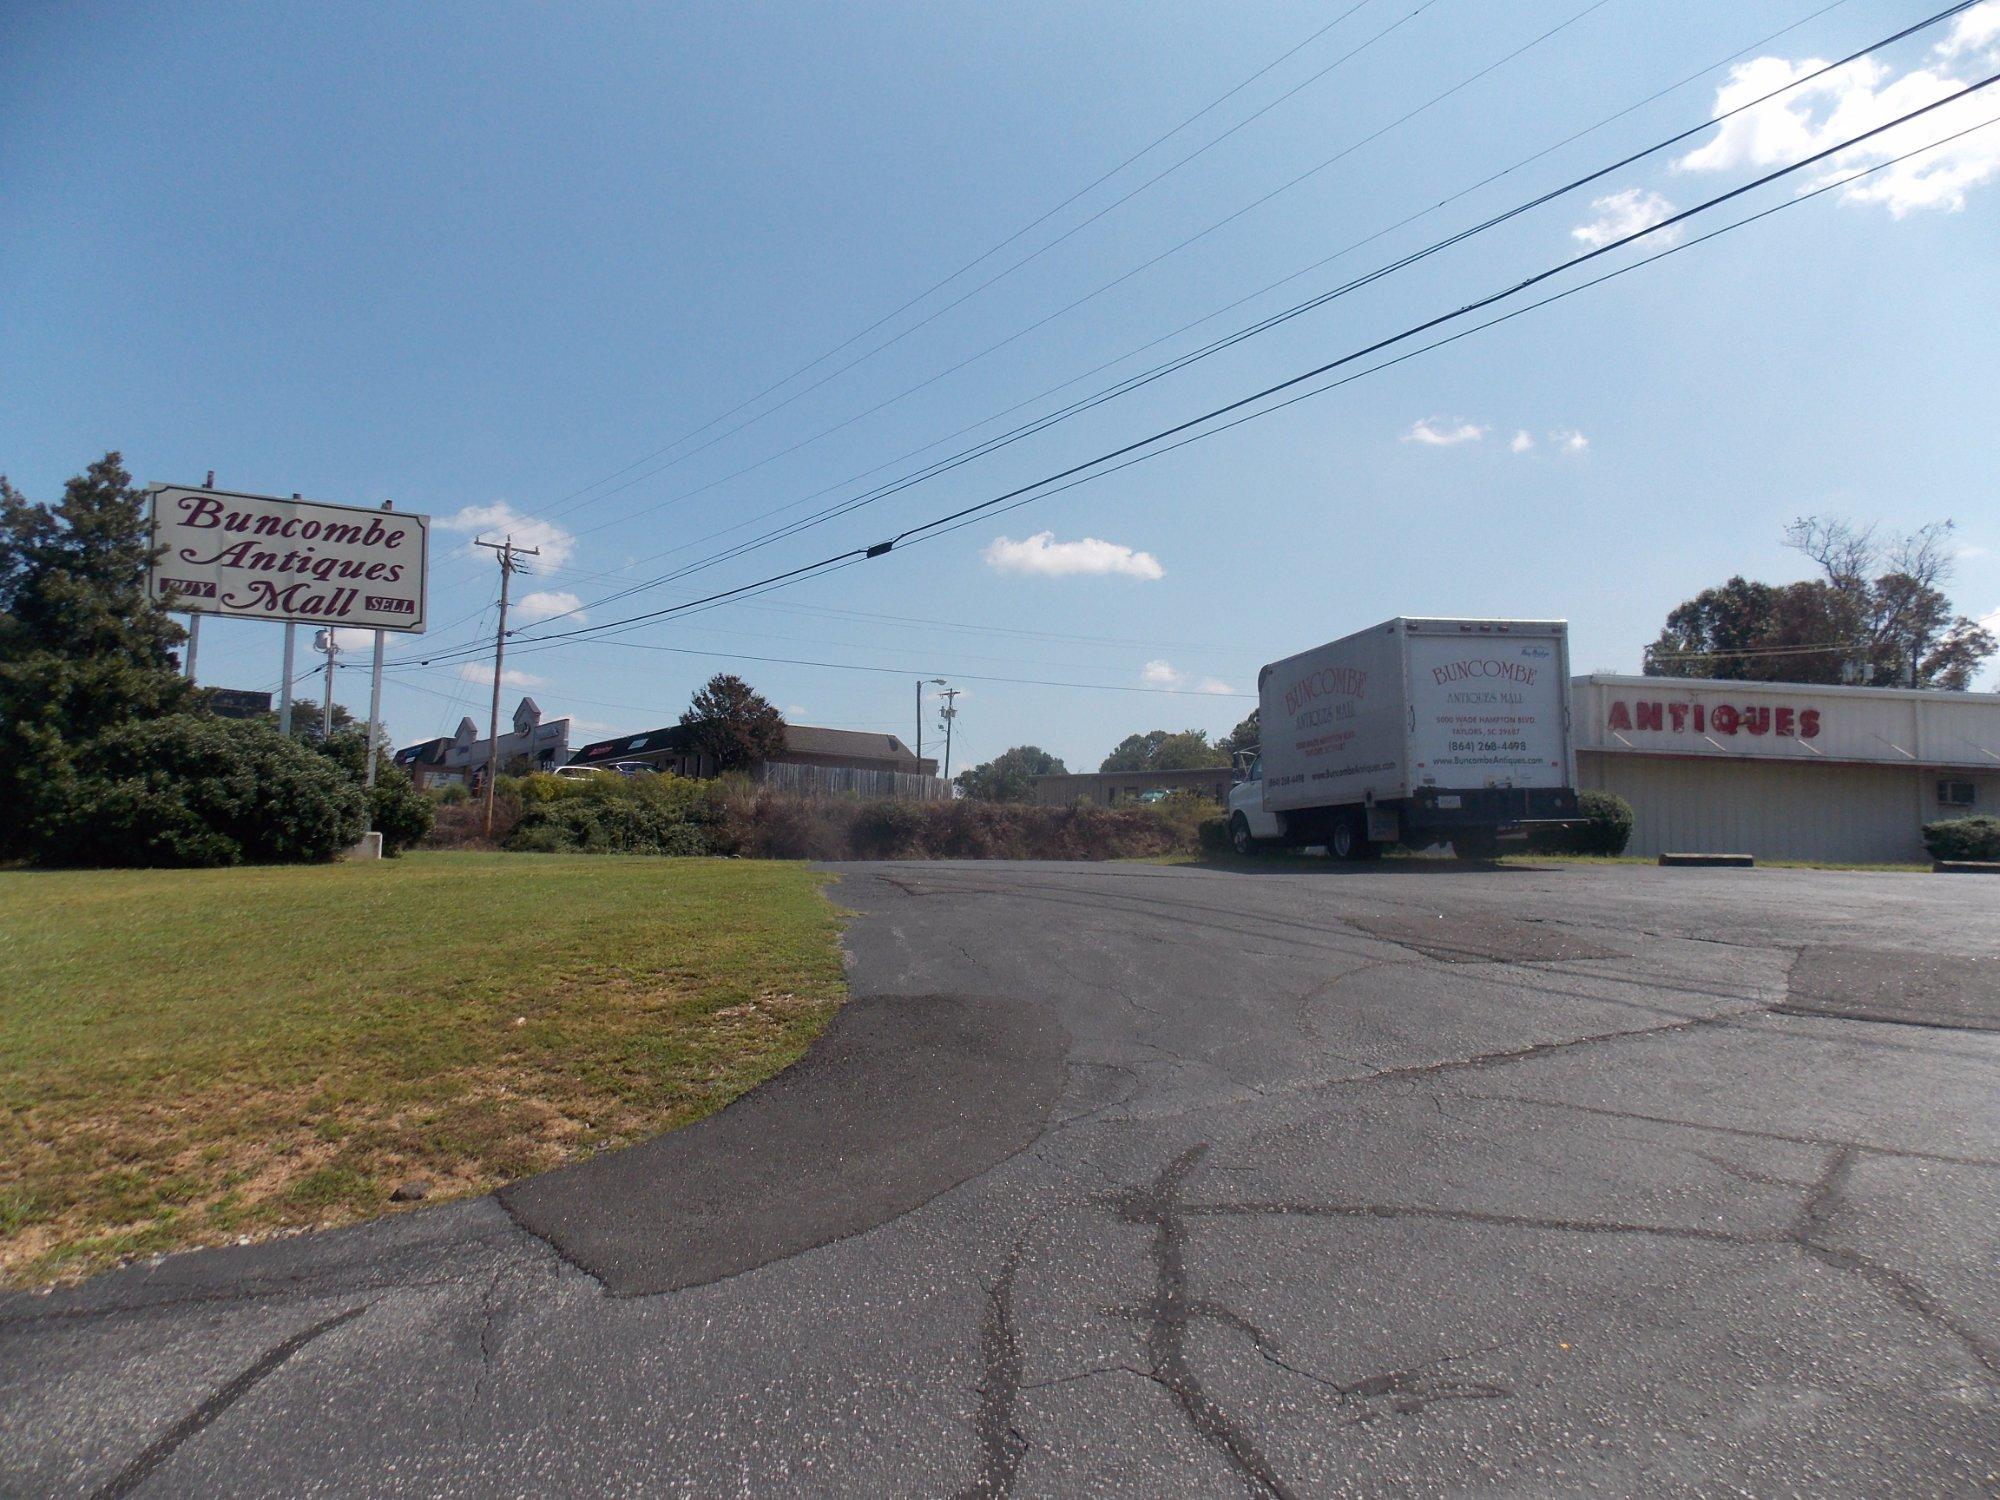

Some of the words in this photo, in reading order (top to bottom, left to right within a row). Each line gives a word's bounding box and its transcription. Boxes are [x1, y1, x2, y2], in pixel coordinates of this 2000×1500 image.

[177, 497, 405, 549] Buncombe
[180, 540, 404, 582] Antiques
[221, 580, 360, 616] Mall
[369, 597, 413, 613] SELL
[1432, 660, 1537, 686] BUNCOMBE
[1285, 668, 1367, 715] BUNCOMBE
[1447, 692, 1497, 704] ANTIQUES
[1501, 692, 1524, 704] MALL
[1479, 716, 1515, 724] HAMPTON
[1608, 701, 1820, 738] ANTIQUES
[1448, 741, 1474, 752] (864)
